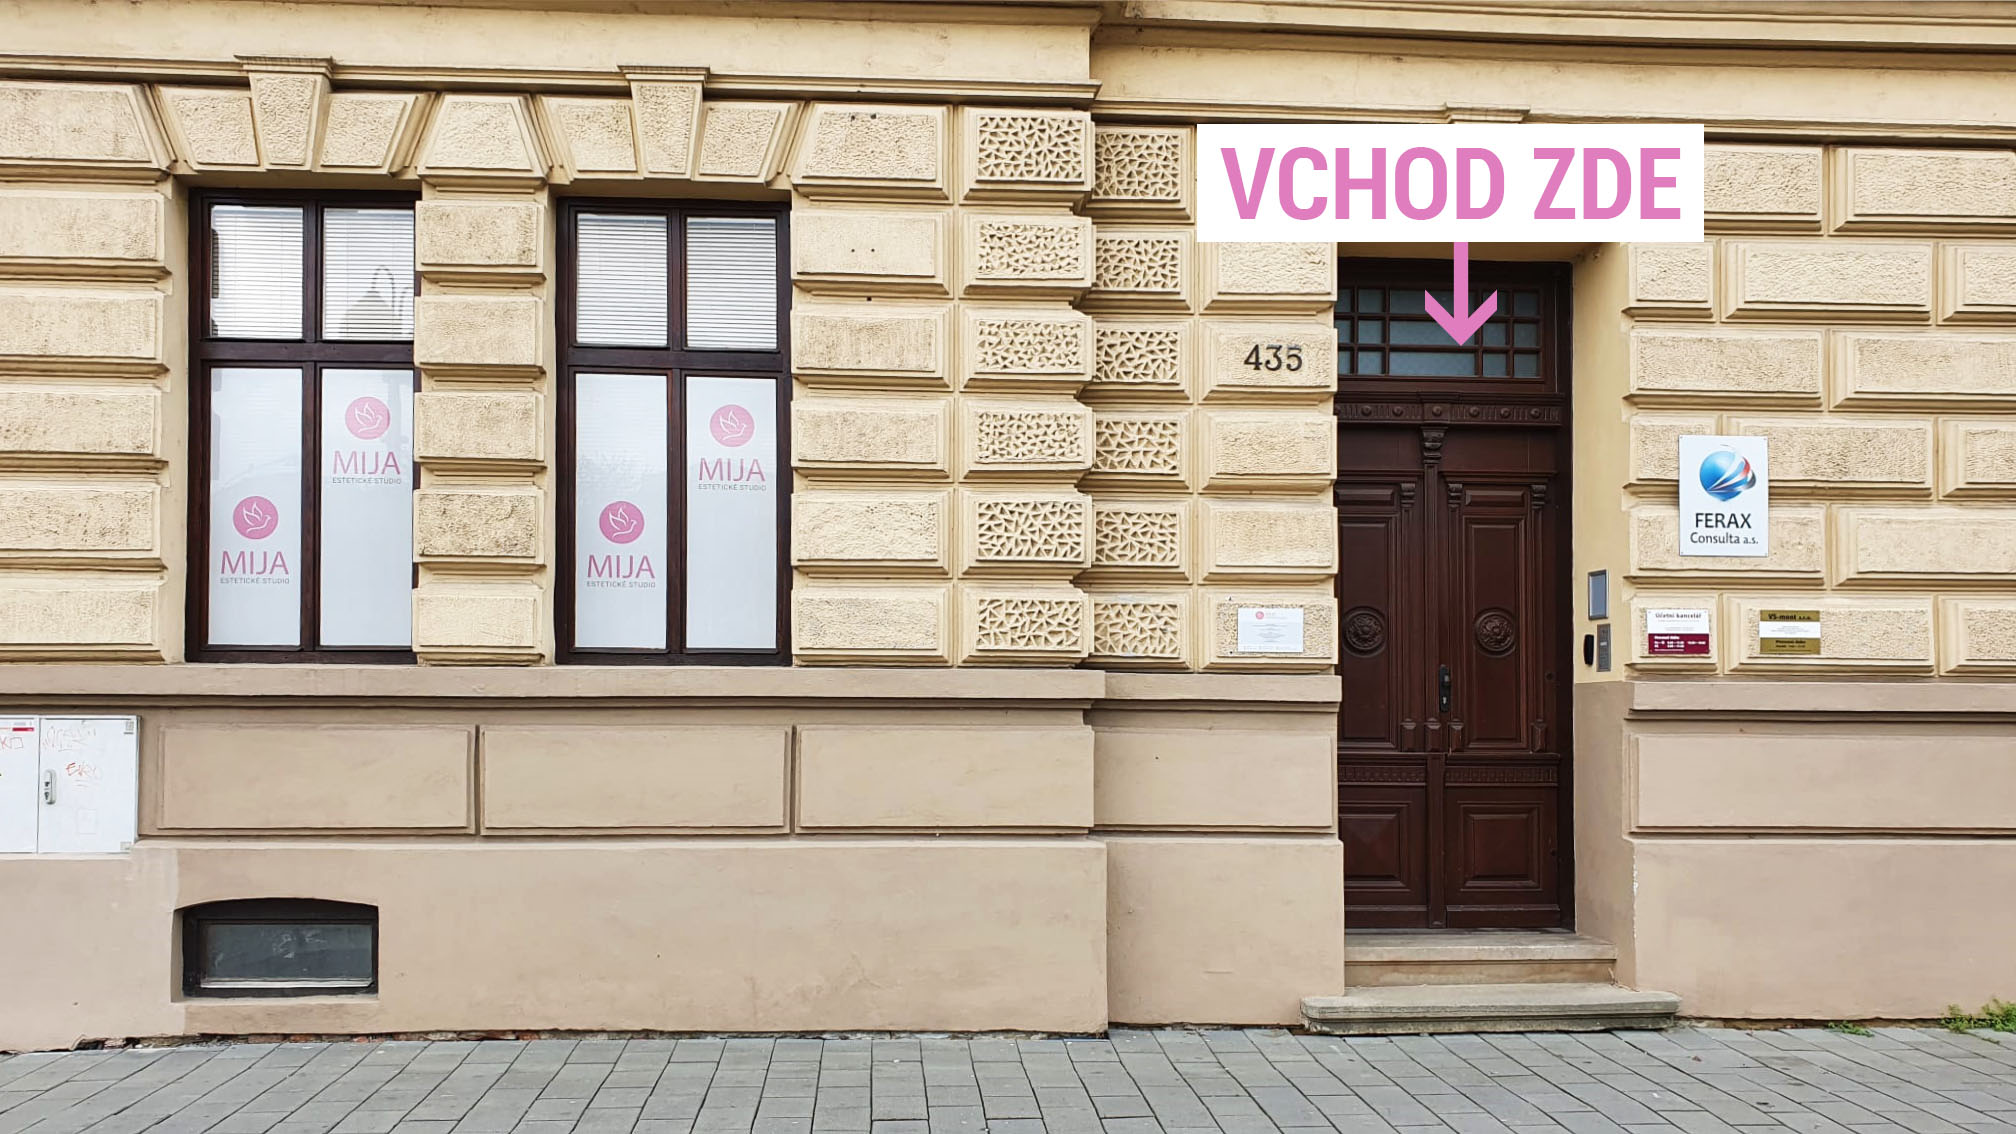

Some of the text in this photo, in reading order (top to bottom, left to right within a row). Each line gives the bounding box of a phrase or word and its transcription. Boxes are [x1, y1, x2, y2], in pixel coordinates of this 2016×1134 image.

[1243, 344, 1303, 371] 435
[332, 450, 401, 475] MIJA
[698, 457, 766, 482] MIJA
[375, 477, 402, 485] STUDIO
[739, 484, 767, 492] STUDIO
[1694, 512, 1752, 529] FERAX
[1690, 532, 1759, 544] Consulta a.s.
[220, 550, 289, 575] MIJA
[587, 554, 656, 579] MIJA
[262, 577, 290, 585] STUDIO
[586, 580, 656, 589] ESTETICKÉ STUDIO
